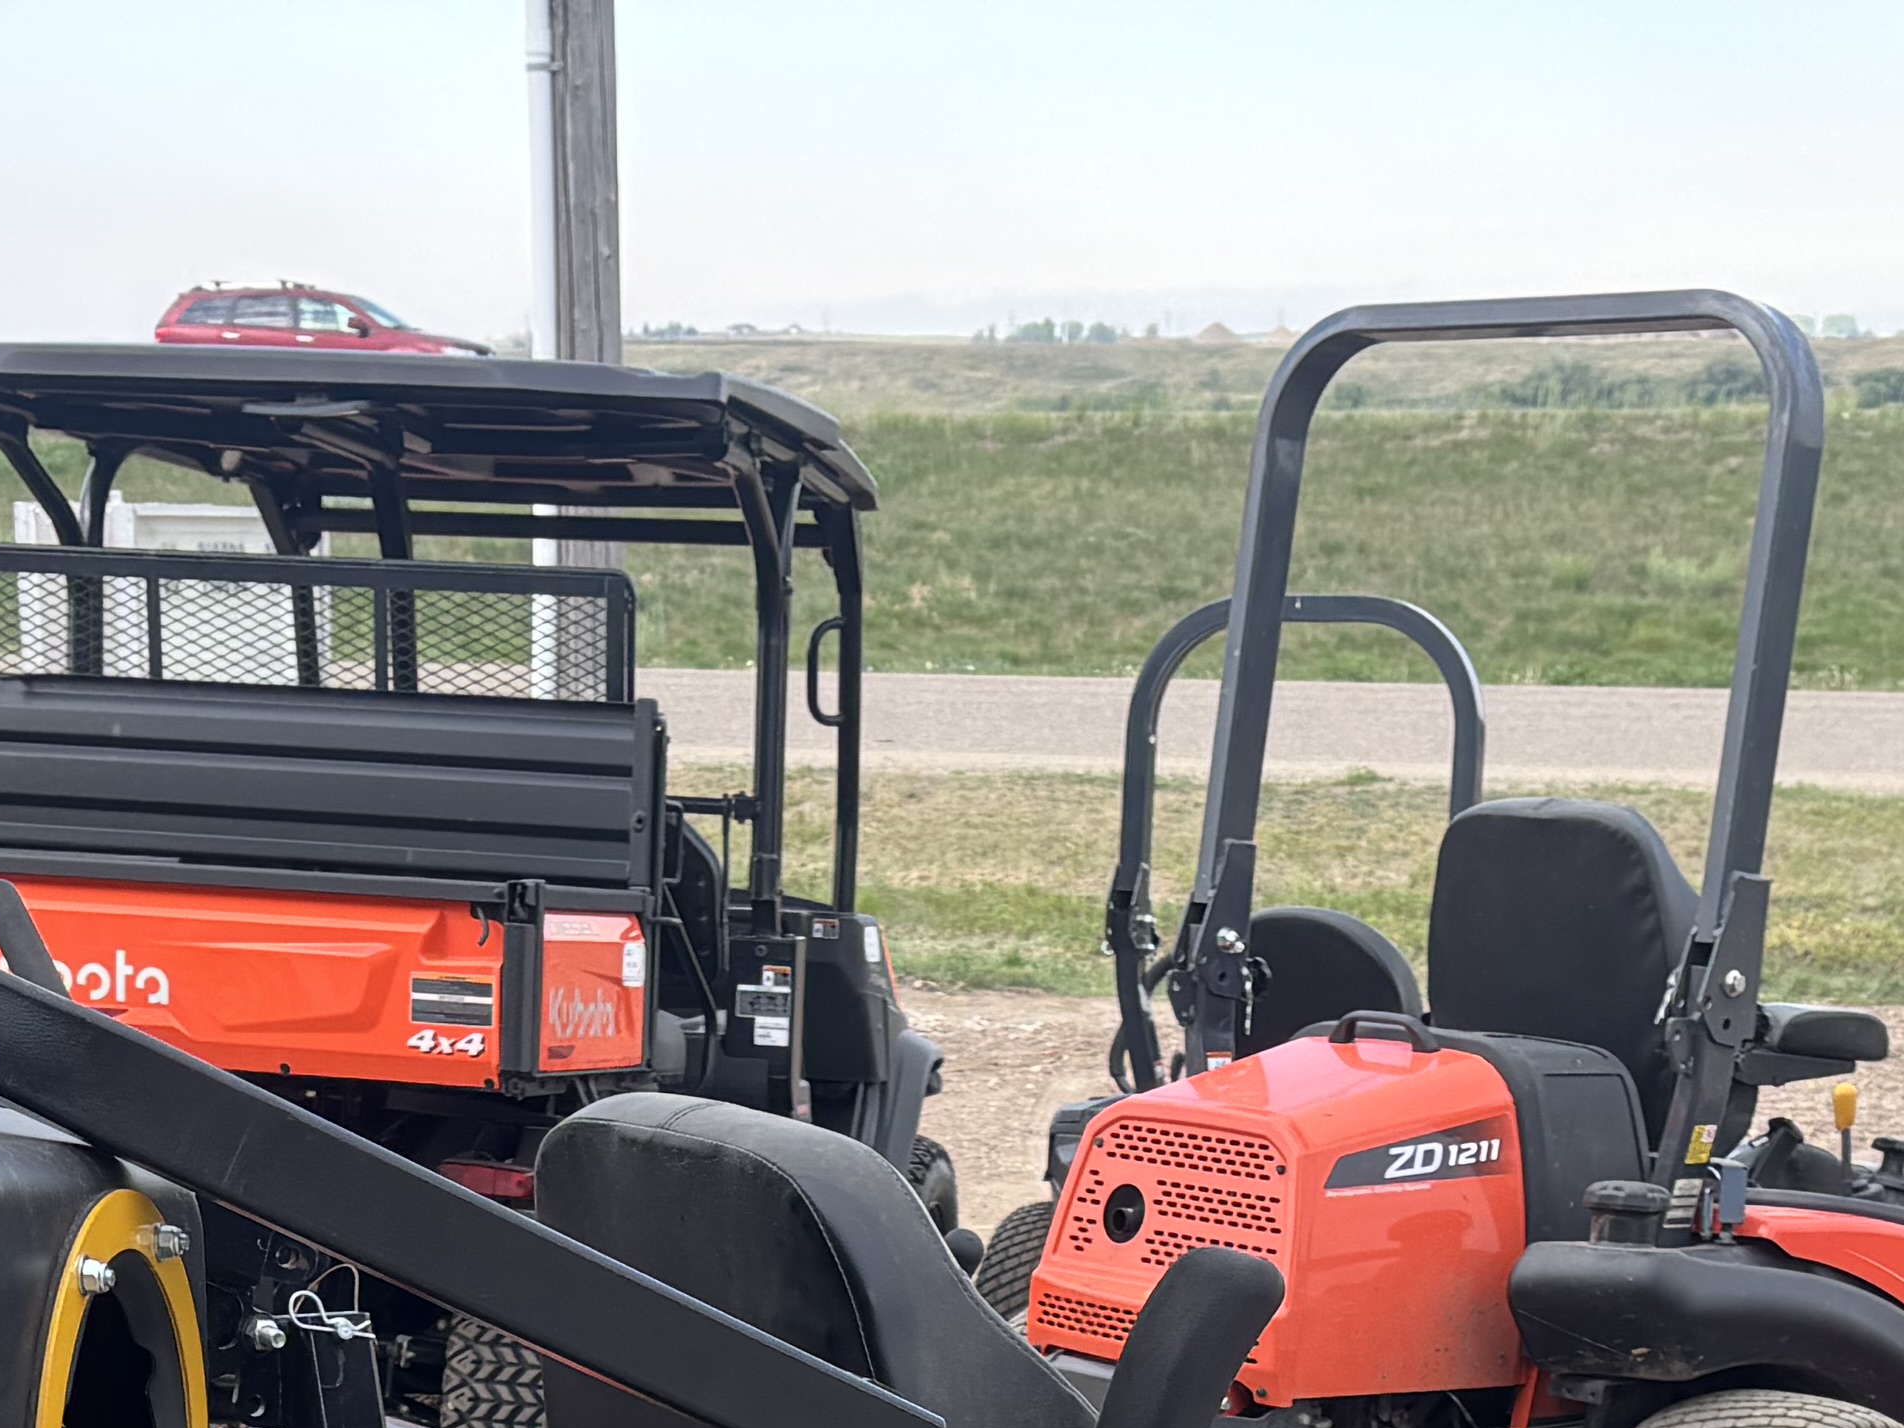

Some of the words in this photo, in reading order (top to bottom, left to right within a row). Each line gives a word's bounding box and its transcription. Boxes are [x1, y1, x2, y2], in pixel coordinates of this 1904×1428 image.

[407, 1029, 485, 1058] 4x4
[1384, 1142, 1443, 1179] ZD
[1448, 1138, 1500, 1166] 1211
